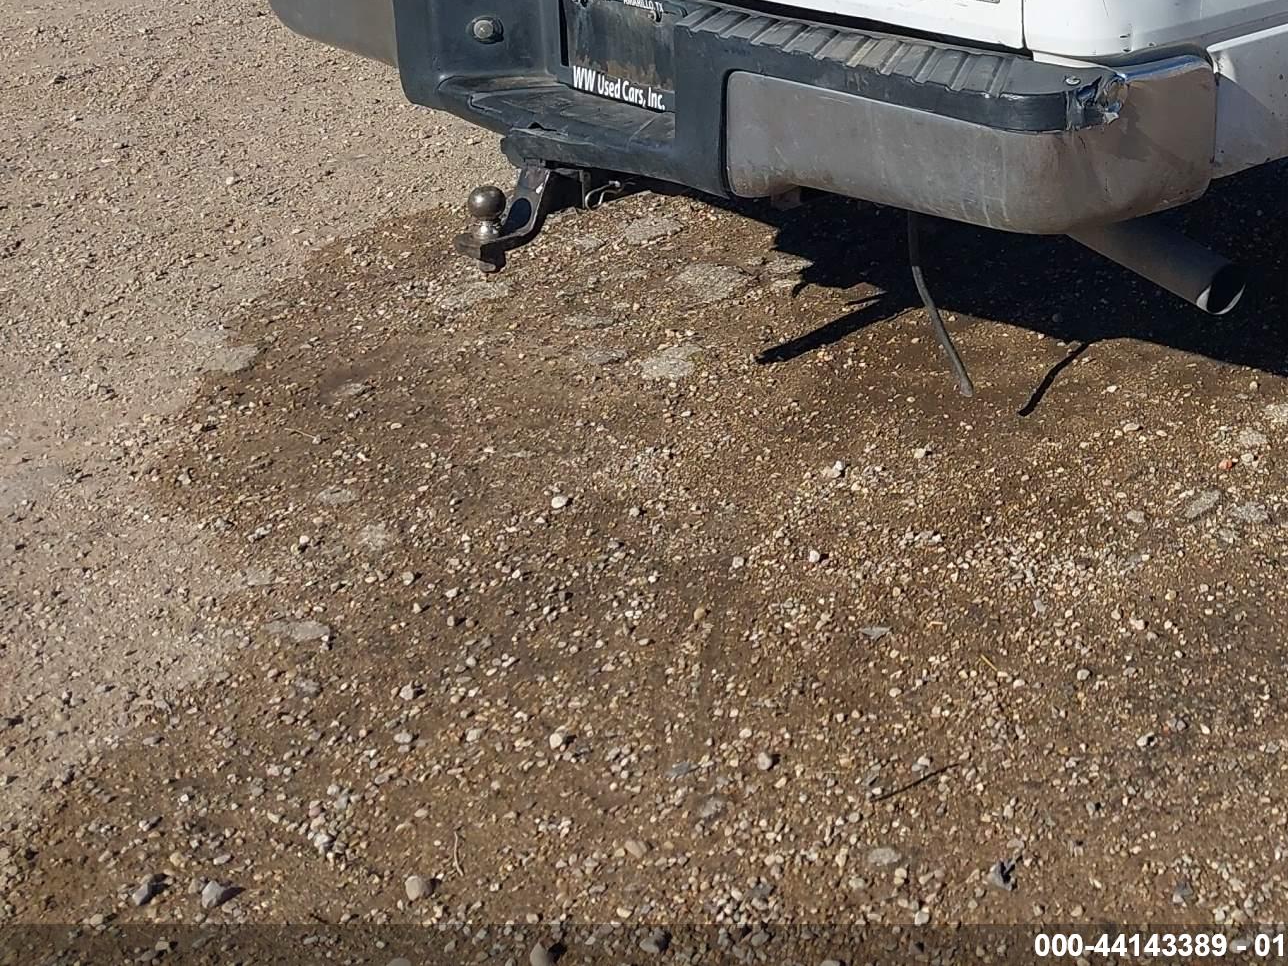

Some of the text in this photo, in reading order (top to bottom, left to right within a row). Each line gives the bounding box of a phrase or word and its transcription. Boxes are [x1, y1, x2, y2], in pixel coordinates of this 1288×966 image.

[573, 65, 666, 111] WW Used Cars, Inc.
